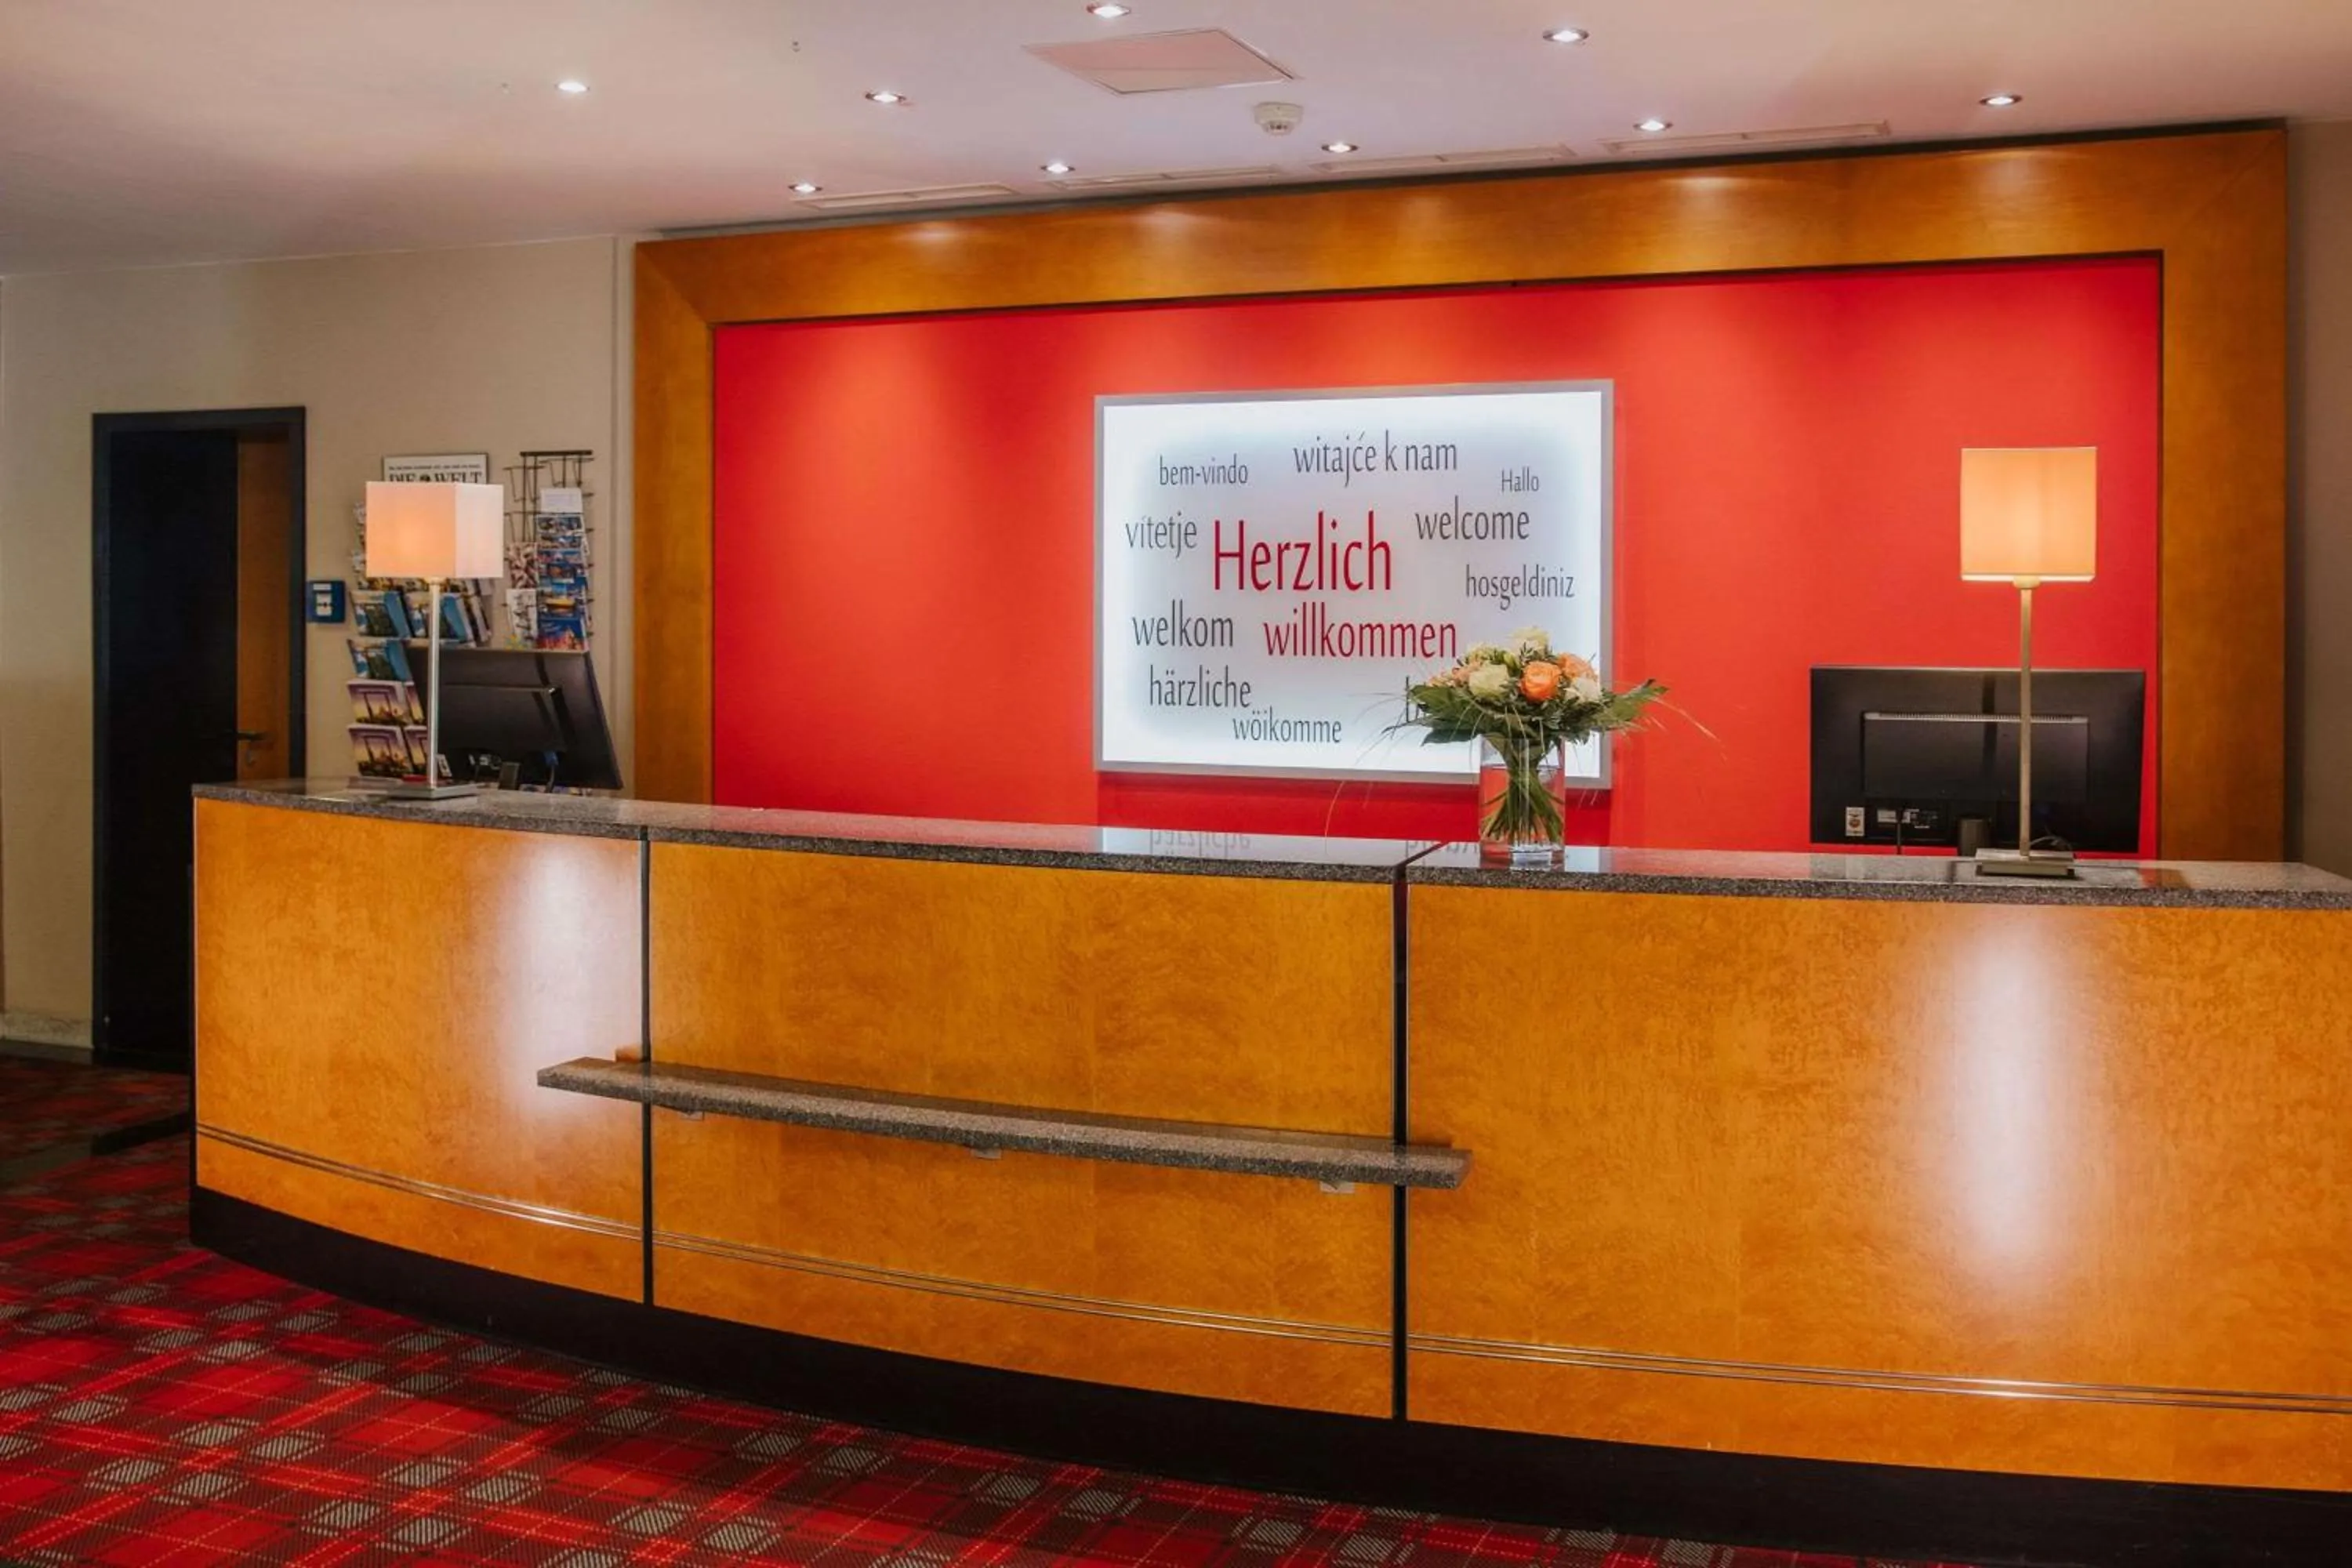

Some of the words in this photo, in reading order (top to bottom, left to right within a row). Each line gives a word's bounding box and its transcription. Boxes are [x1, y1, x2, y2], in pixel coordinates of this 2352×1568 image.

[1160, 453, 1249, 485] bem-vindo
[1294, 431, 1377, 488] witajće
[1385, 429, 1398, 471] k
[1405, 444, 1457, 471] nam
[1501, 466, 1539, 492] Hallo
[1415, 495, 1530, 540] welcome
[1214, 510, 1392, 593] Herzlich
[1465, 564, 1574, 611] hosgeldiniz
[1132, 598, 1233, 648] welkom
[1263, 602, 1456, 659] willkommen
[1149, 664, 1251, 708] härzliche
[1232, 705, 1342, 743] wöikomme
